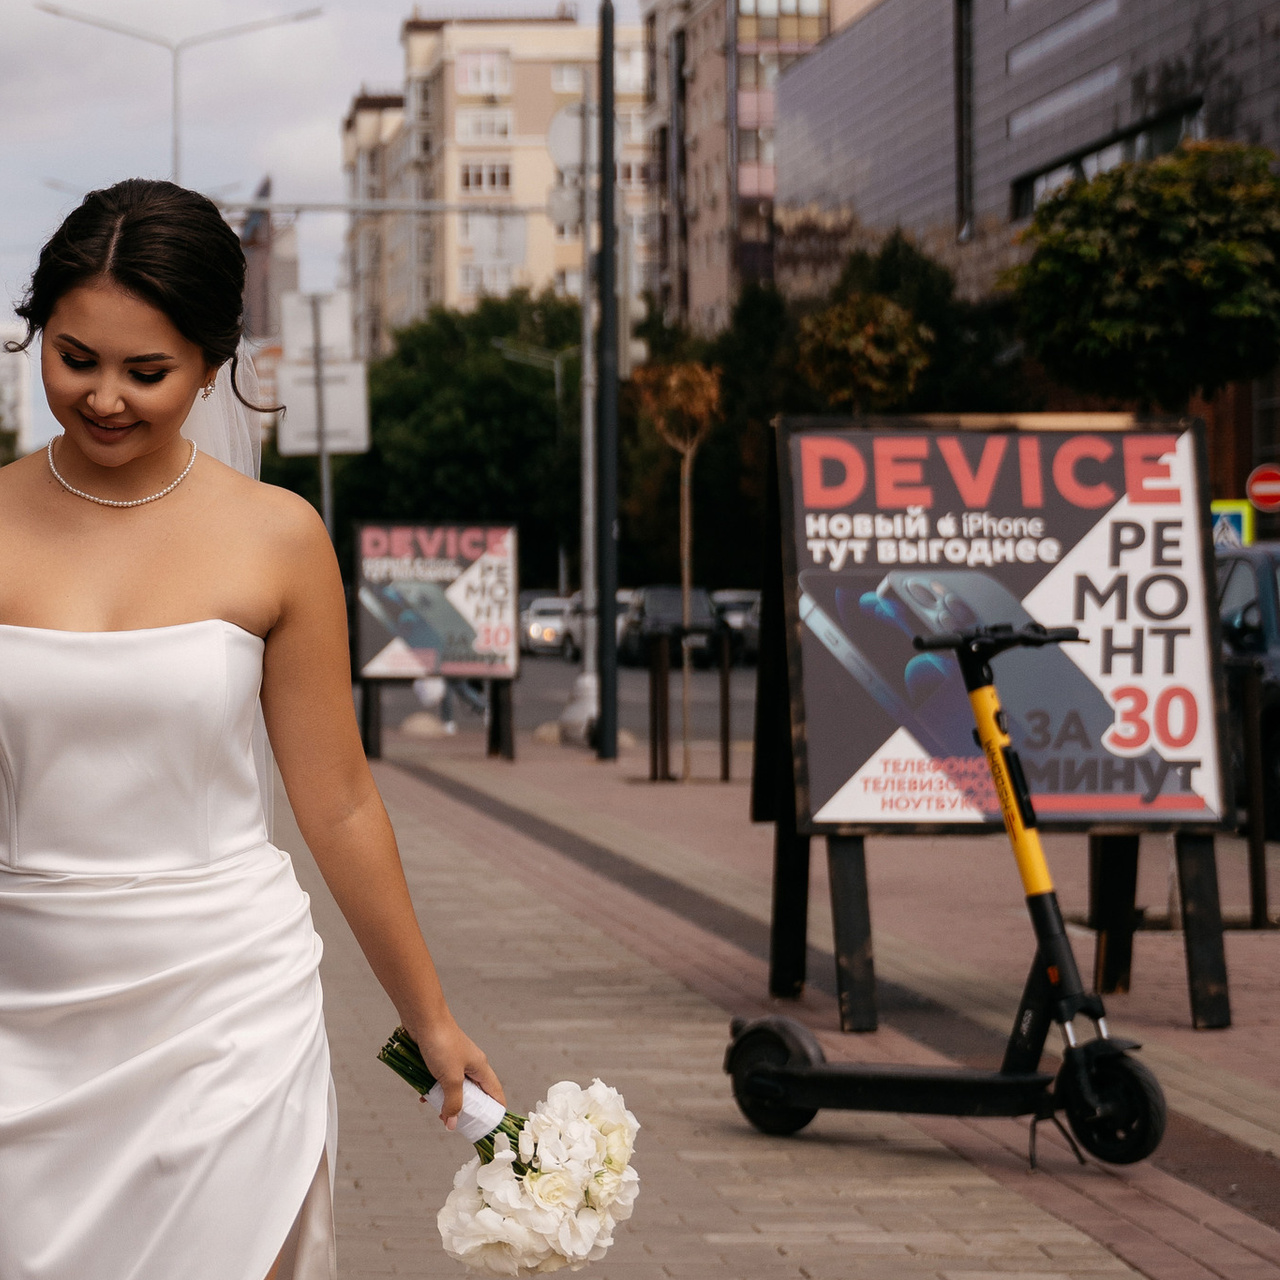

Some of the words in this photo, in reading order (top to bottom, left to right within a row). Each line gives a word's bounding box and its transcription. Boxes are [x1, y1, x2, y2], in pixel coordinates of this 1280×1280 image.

[799, 434, 1182, 510] DEVICE
[961, 512, 1045, 539] iPhone
[360, 526, 509, 561] DEVICE
[1106, 686, 1199, 750] 30
[880, 756, 989, 774] ТЕЛЕФОНО
